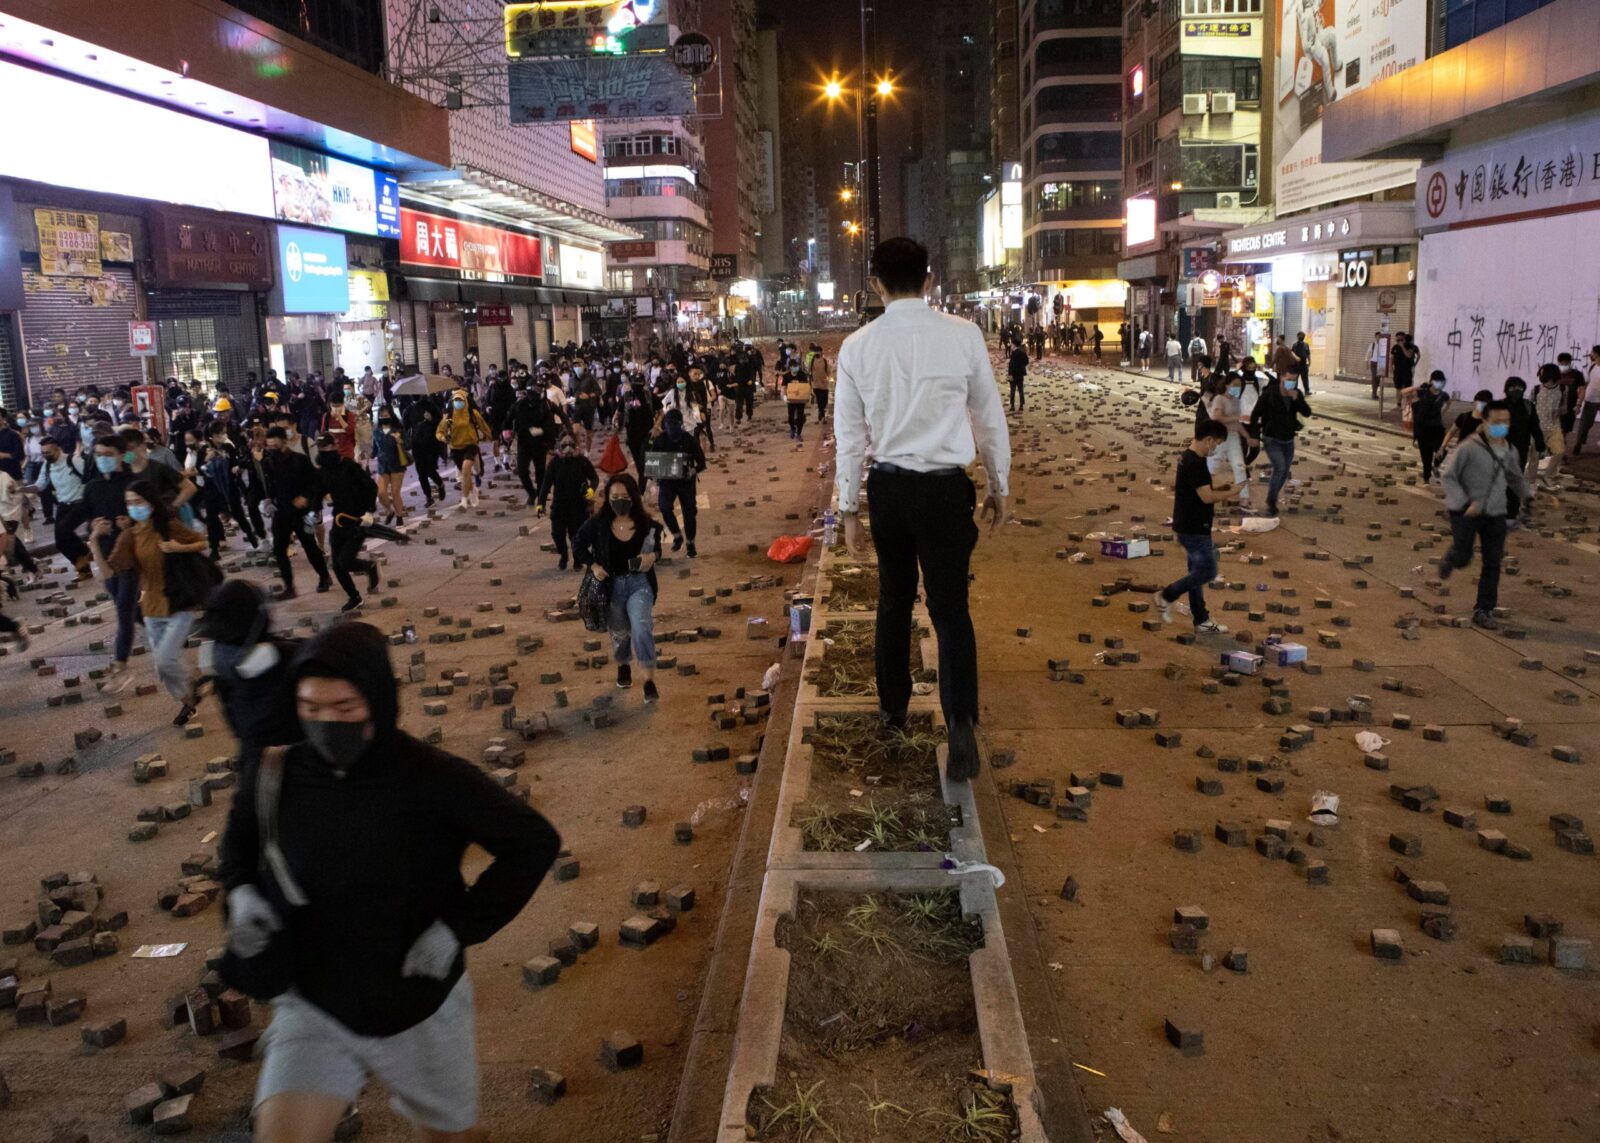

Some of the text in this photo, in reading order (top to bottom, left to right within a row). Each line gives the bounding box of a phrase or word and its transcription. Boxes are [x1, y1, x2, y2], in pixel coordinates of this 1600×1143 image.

[416, 221, 458, 260] 周大福
[1231, 230, 1287, 252] RIGHTEOUS CENTRE
[229, 262, 258, 275] CENTRE
